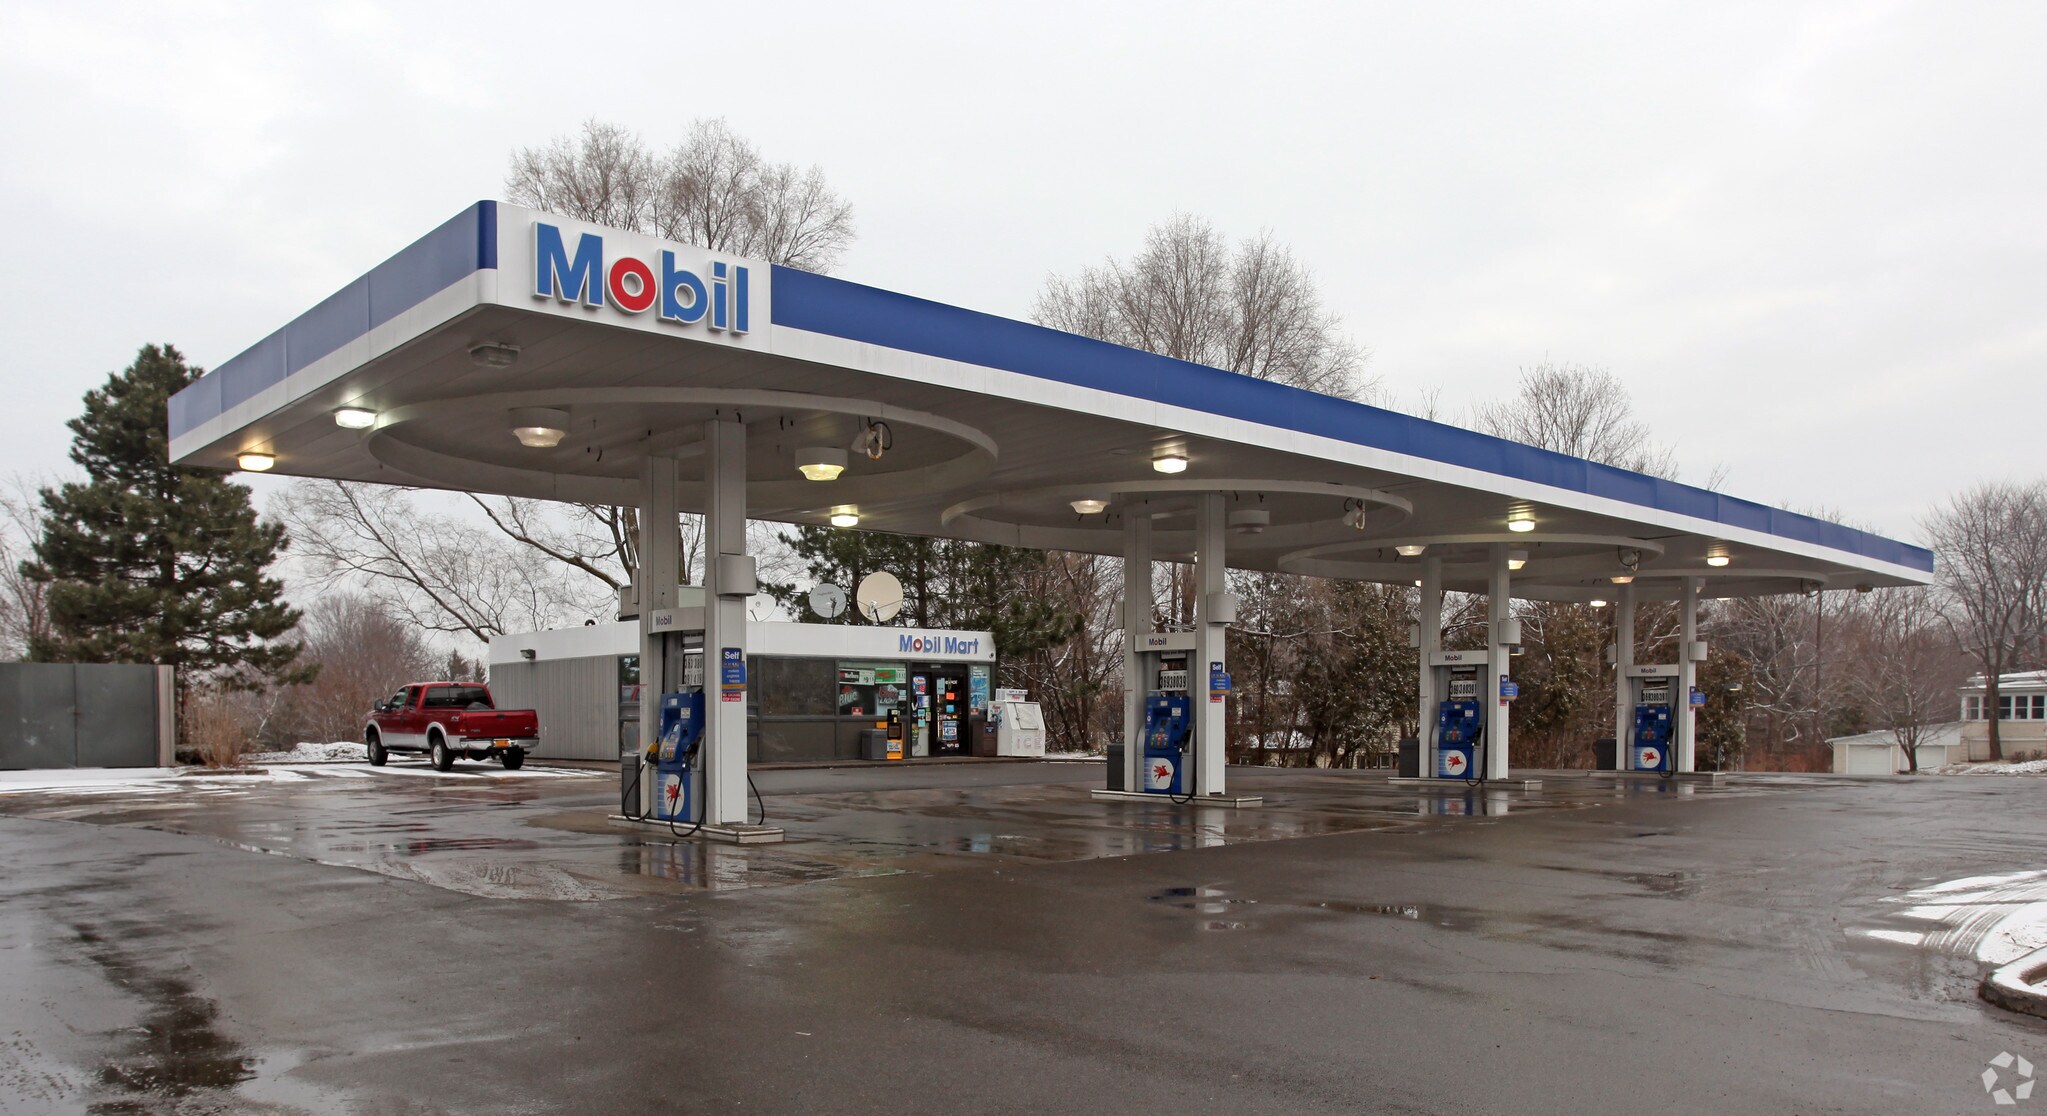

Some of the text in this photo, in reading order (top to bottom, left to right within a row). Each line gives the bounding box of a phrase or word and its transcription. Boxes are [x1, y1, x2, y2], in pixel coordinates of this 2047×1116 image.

[531, 221, 749, 335] Mobil
[655, 614, 672, 626] Mobil
[899, 634, 979, 654] Mobil Mart
[1148, 637, 1167, 646] Mobil
[724, 651, 740, 660] Self
[1444, 654, 1463, 662] Mobil
[1016, 735, 1042, 750] ICE
